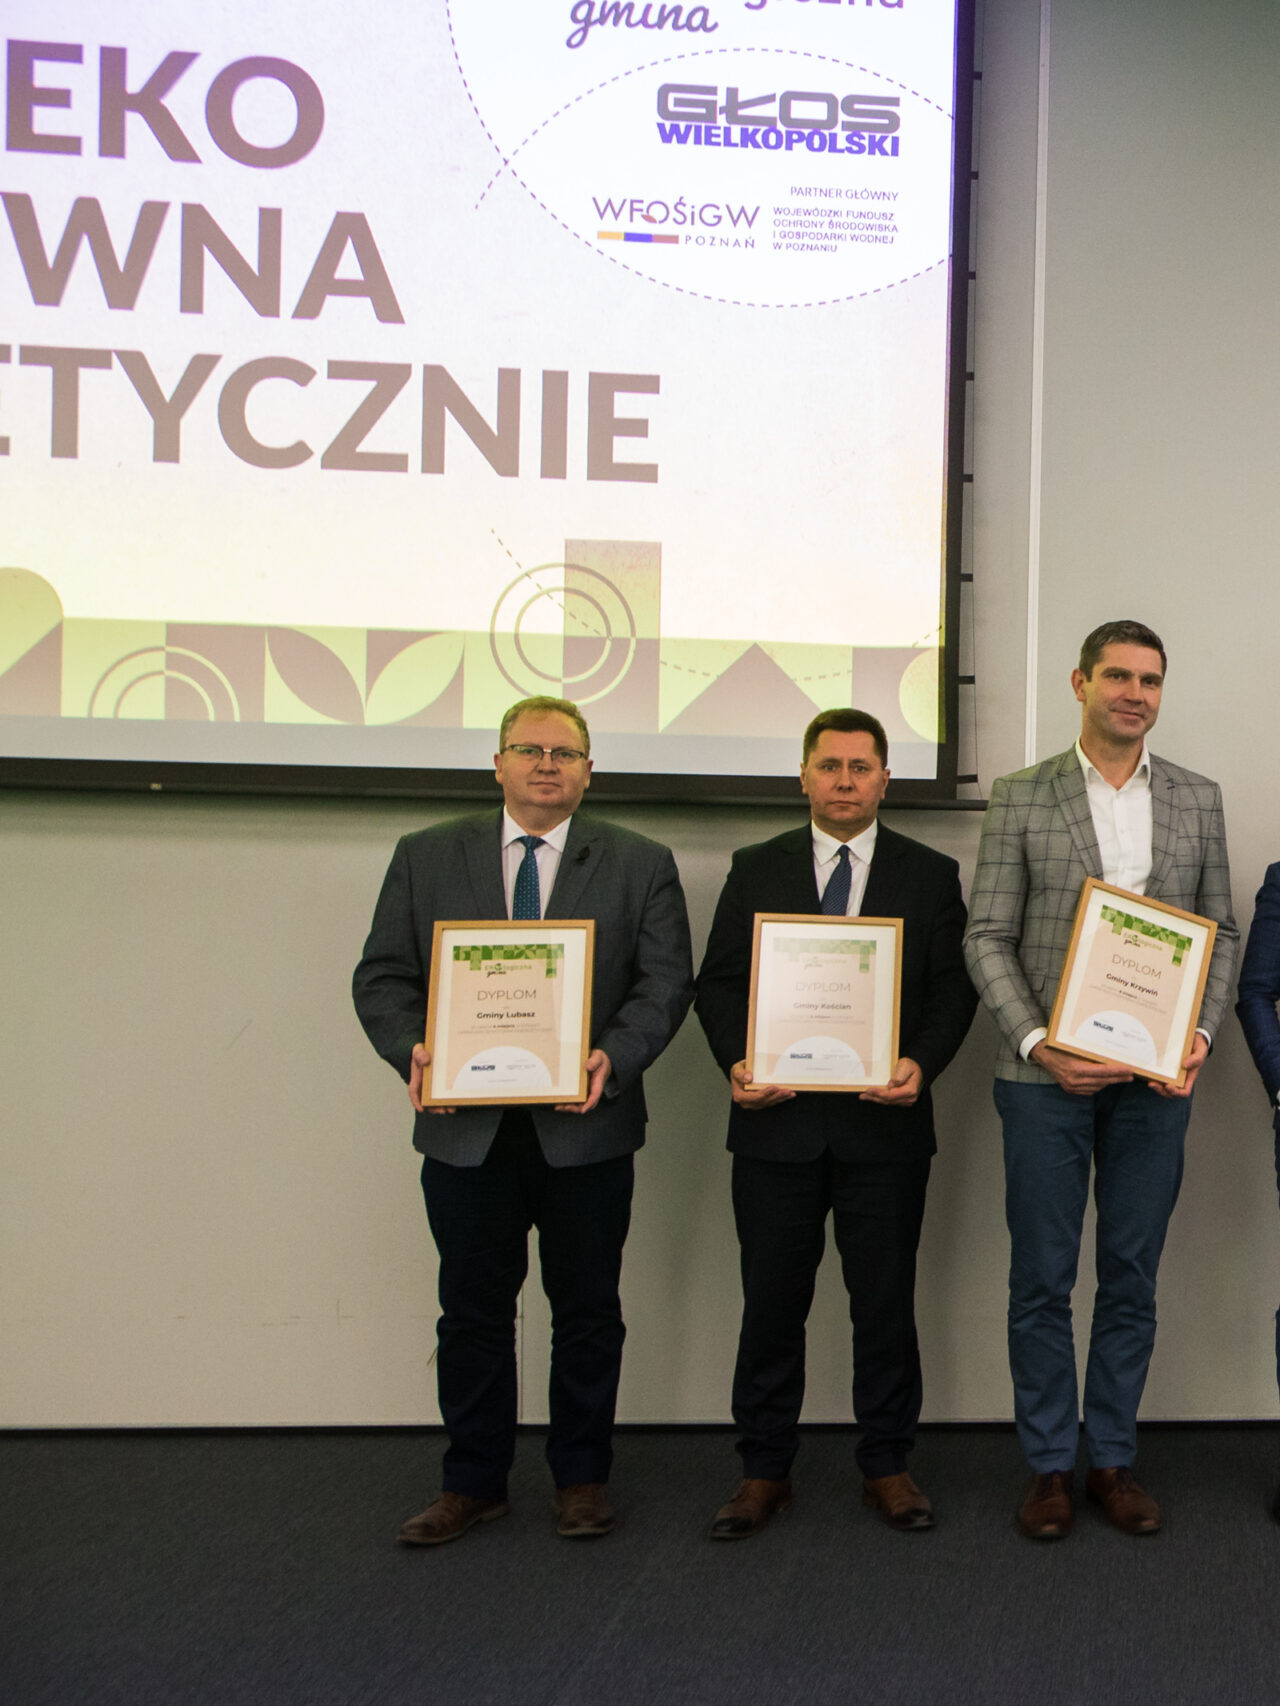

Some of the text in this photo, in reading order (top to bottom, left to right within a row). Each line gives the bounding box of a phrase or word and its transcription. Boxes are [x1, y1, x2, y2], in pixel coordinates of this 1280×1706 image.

[4, 38, 325, 168] EKO
[656, 83, 901, 134] GŁOS
[656, 122, 900, 157] WIELKOPOLSKI
[790, 186, 900, 201] PARTNER GŁÓWNY
[592, 196, 761, 229] WFOŚiGW
[773, 207, 895, 221] WOJEWÓDZKI FUNDUSZ
[773, 218, 899, 233] OCHRONY ŚRODOWISKA
[684, 235, 756, 249] POZNAŃ
[779, 230, 847, 242] GOSPODARKI
[849, 233, 895, 245] WODNEJ
[772, 242, 838, 253] W POZNANIU
[0, 191, 406, 325] WNA
[0, 344, 661, 484] TYCZNIE
[1111, 953, 1162, 979] DYPLOM
[795, 982, 851, 992] DYPLOM
[1105, 973, 1129, 987] Gminy
[477, 989, 537, 1001] DYPLOM
[476, 1011, 536, 1020] Gminy Lubasz
